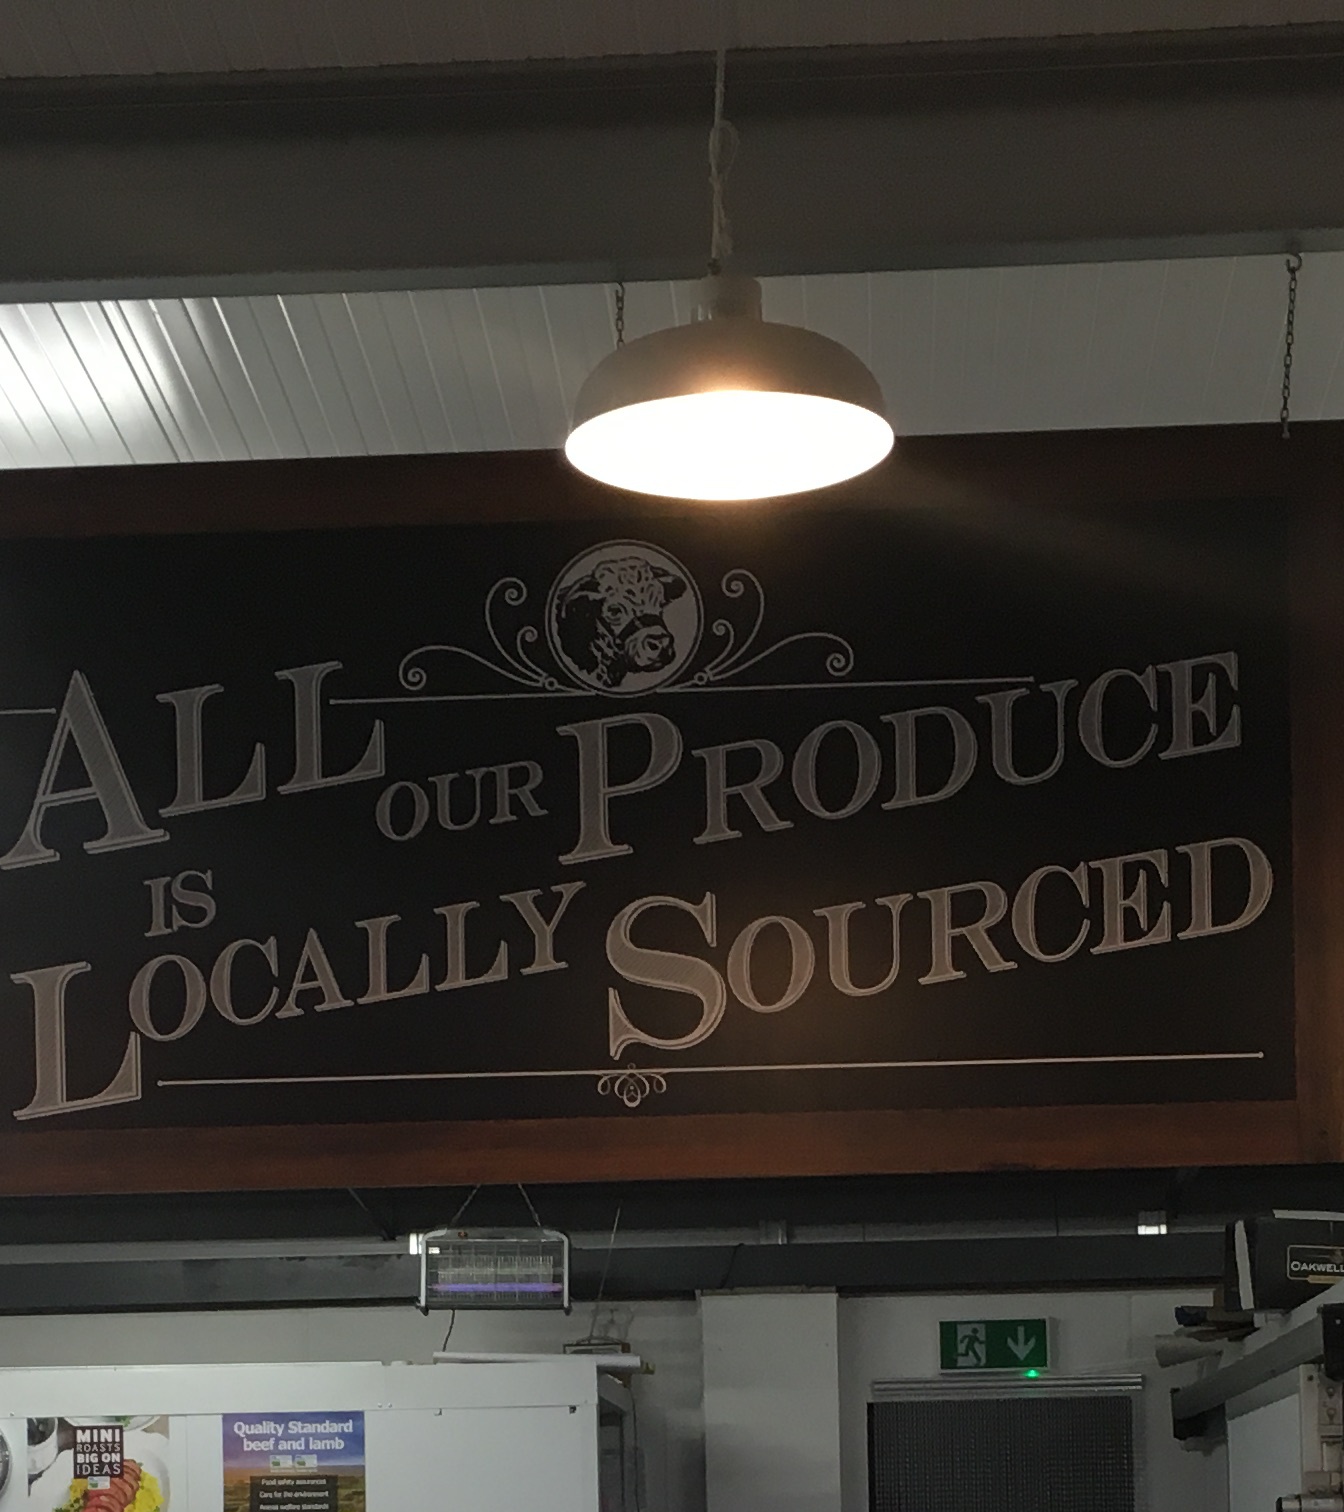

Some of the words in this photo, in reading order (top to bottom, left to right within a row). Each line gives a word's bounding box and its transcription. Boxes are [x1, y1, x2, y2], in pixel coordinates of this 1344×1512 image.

[375, 759, 549, 842] OUR
[556, 650, 1242, 865] PRODUCE
[143, 869, 218, 938] IS
[10, 880, 588, 1121] LOCALLY
[605, 836, 1274, 1060] SOURCED
[233, 1420, 285, 1437] Quality
[288, 1419, 354, 1433] Standard
[77, 1429, 121, 1443] MINI
[76, 1443, 121, 1452] ROASTS
[243, 1438, 275, 1451] beef
[278, 1437, 305, 1450] and
[309, 1437, 345, 1450] lamb
[76, 1453, 98, 1463] BIG
[101, 1452, 121, 1463] ON
[76, 1464, 121, 1475] IDEAS
